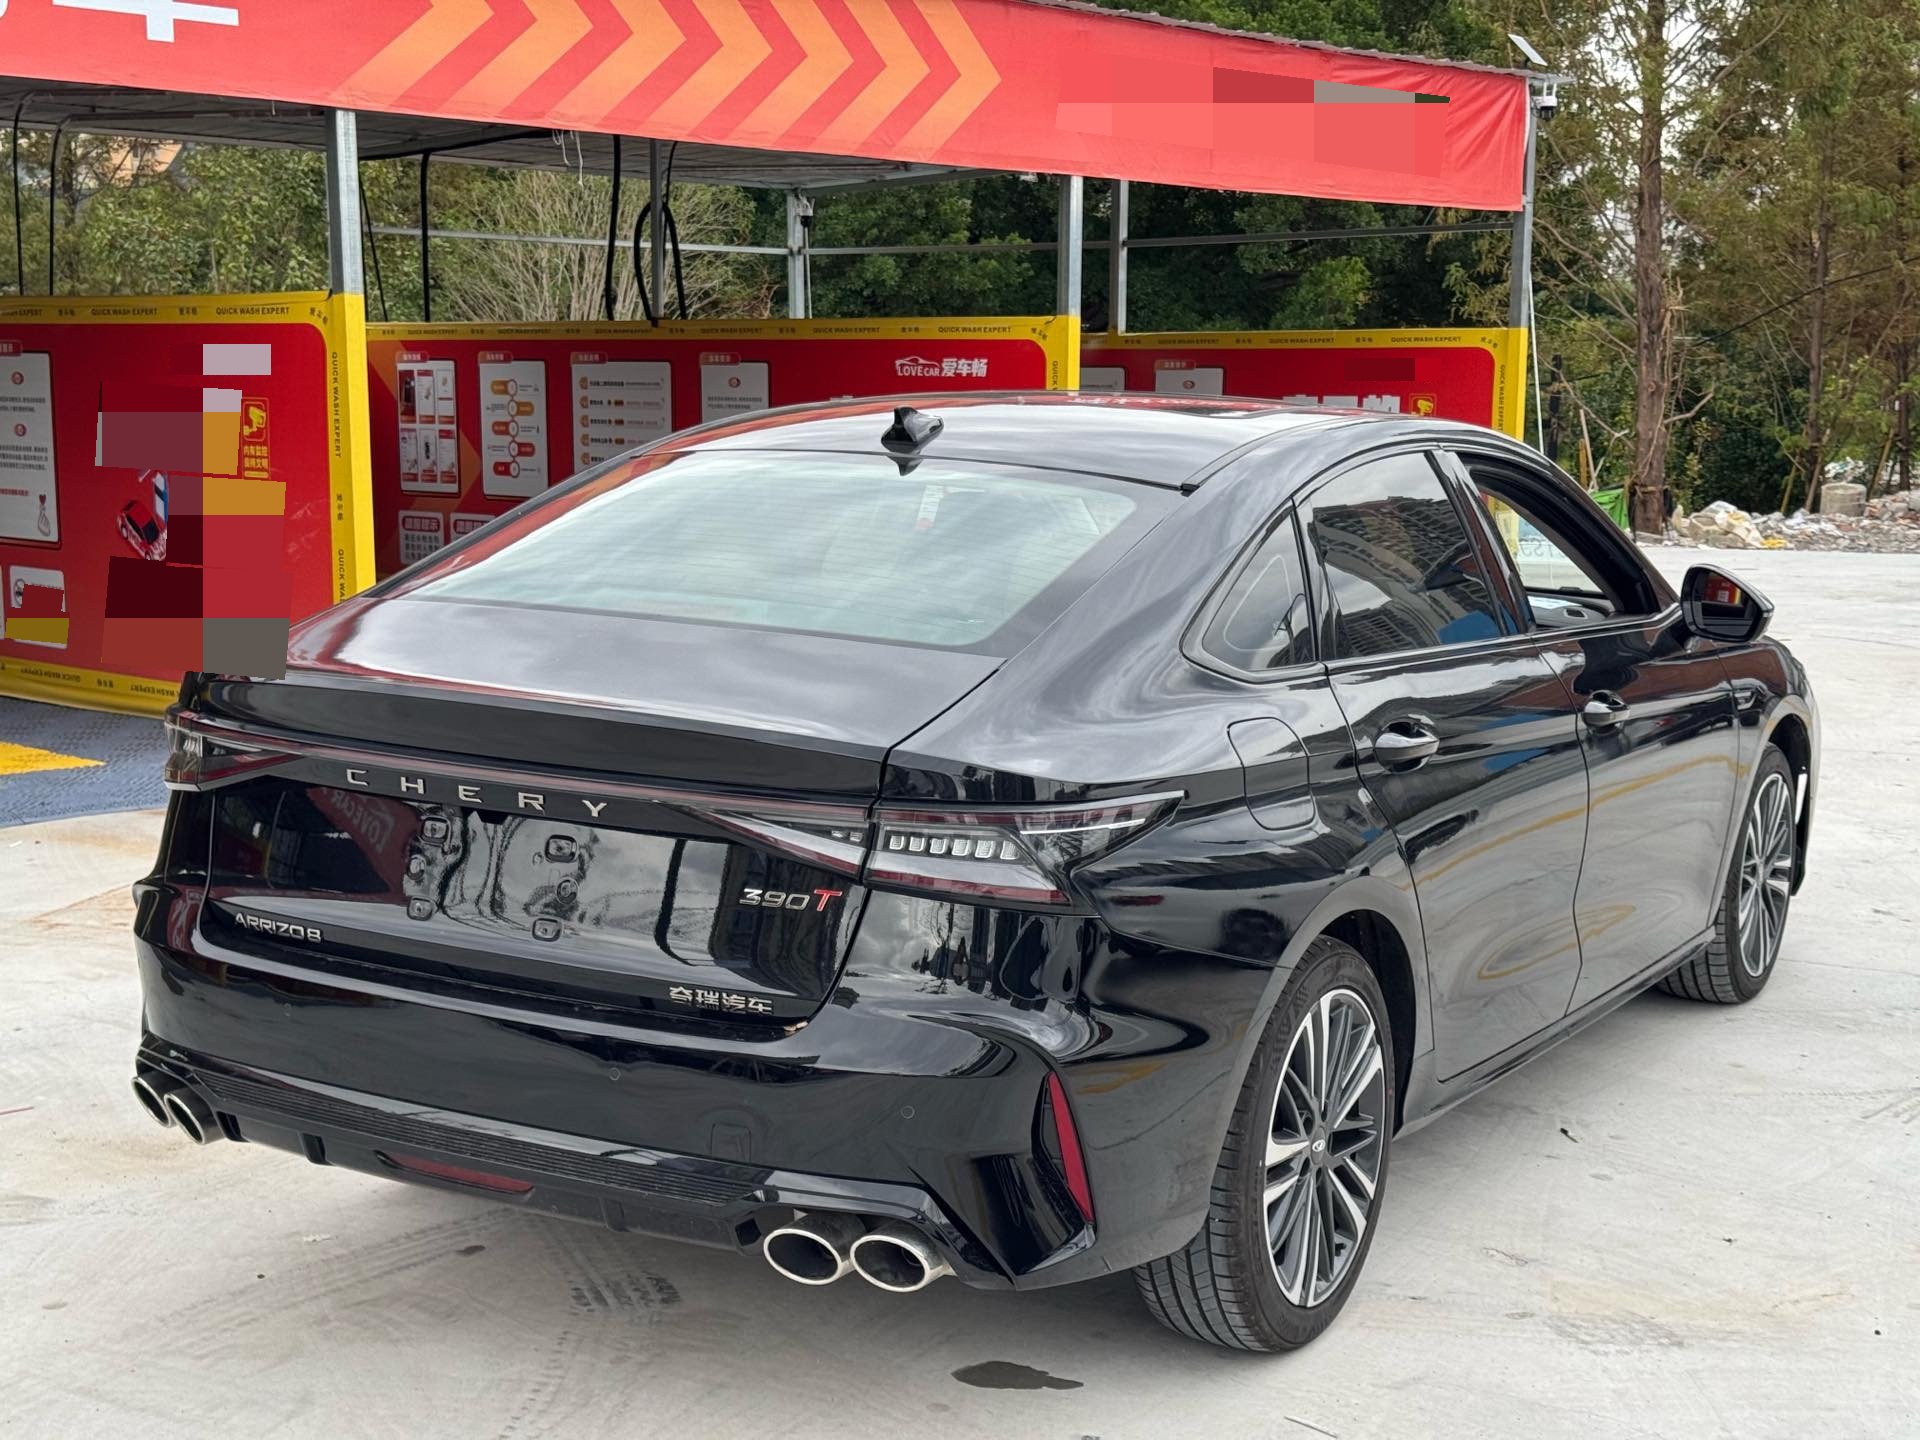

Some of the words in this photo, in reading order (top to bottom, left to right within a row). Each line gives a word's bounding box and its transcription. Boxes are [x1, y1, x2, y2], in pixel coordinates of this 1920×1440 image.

[91, 308, 111, 316] QUICK
[132, 307, 157, 316] EXPERT
[216, 306, 239, 315] QUICK
[240, 306, 260, 315] WASH
[261, 306, 289, 315] EXPERT
[332, 351, 340, 383] QUICK
[941, 358, 988, 377] 爱车畅
[334, 418, 342, 458] EXPERT
[338, 548, 346, 580] QUICK
[346, 768, 608, 818] CHERY
[669, 986, 773, 1013] 奇瑞汽车
